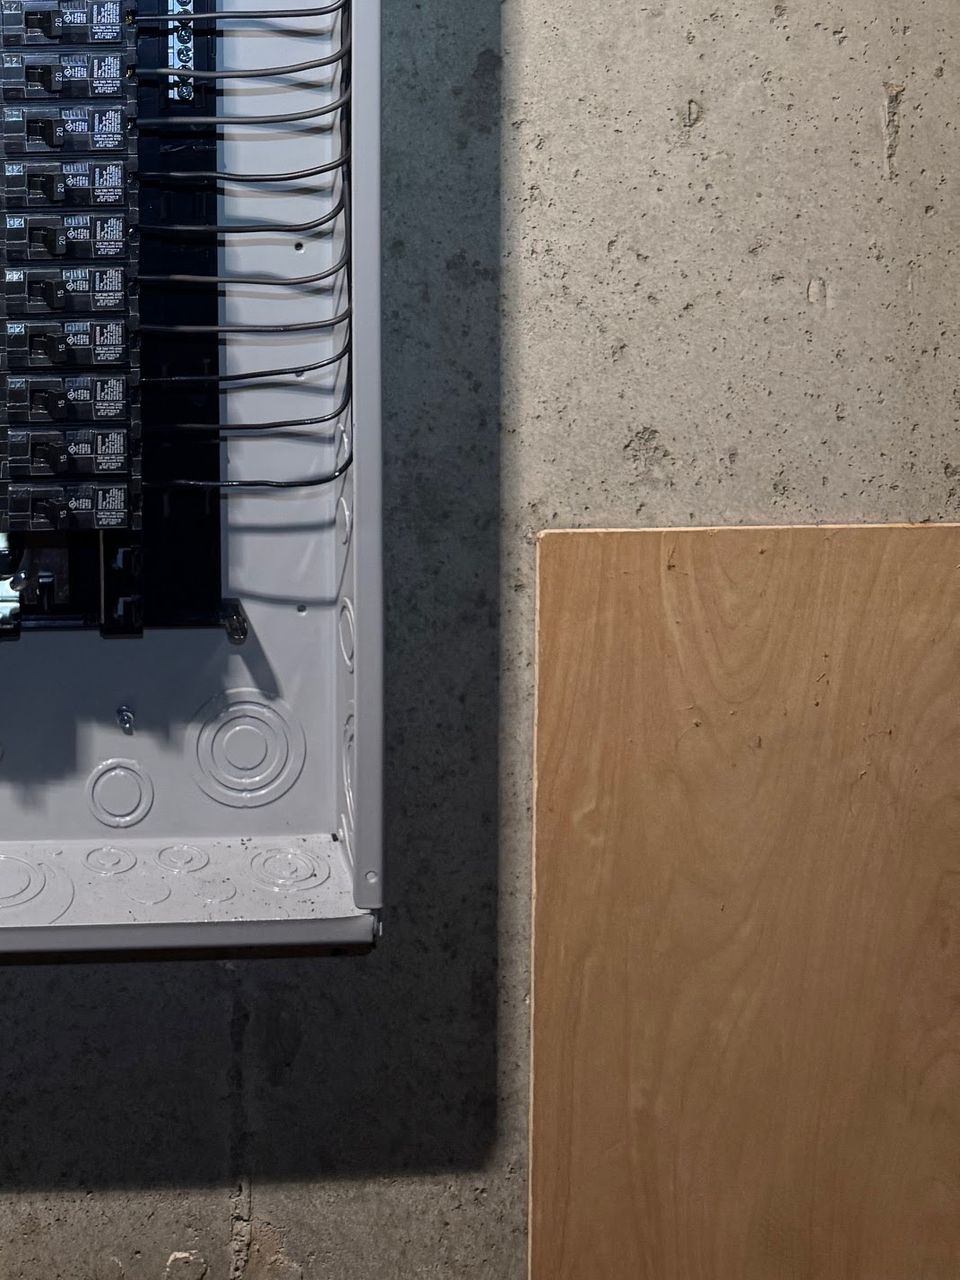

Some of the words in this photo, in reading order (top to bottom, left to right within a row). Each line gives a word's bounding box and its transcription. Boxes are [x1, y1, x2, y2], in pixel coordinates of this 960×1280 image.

[56, 18, 62, 28] 20
[56, 73, 63, 82] 20
[56, 127, 63, 137] 20
[57, 183, 64, 193] 20
[58, 236, 66, 245] 20
